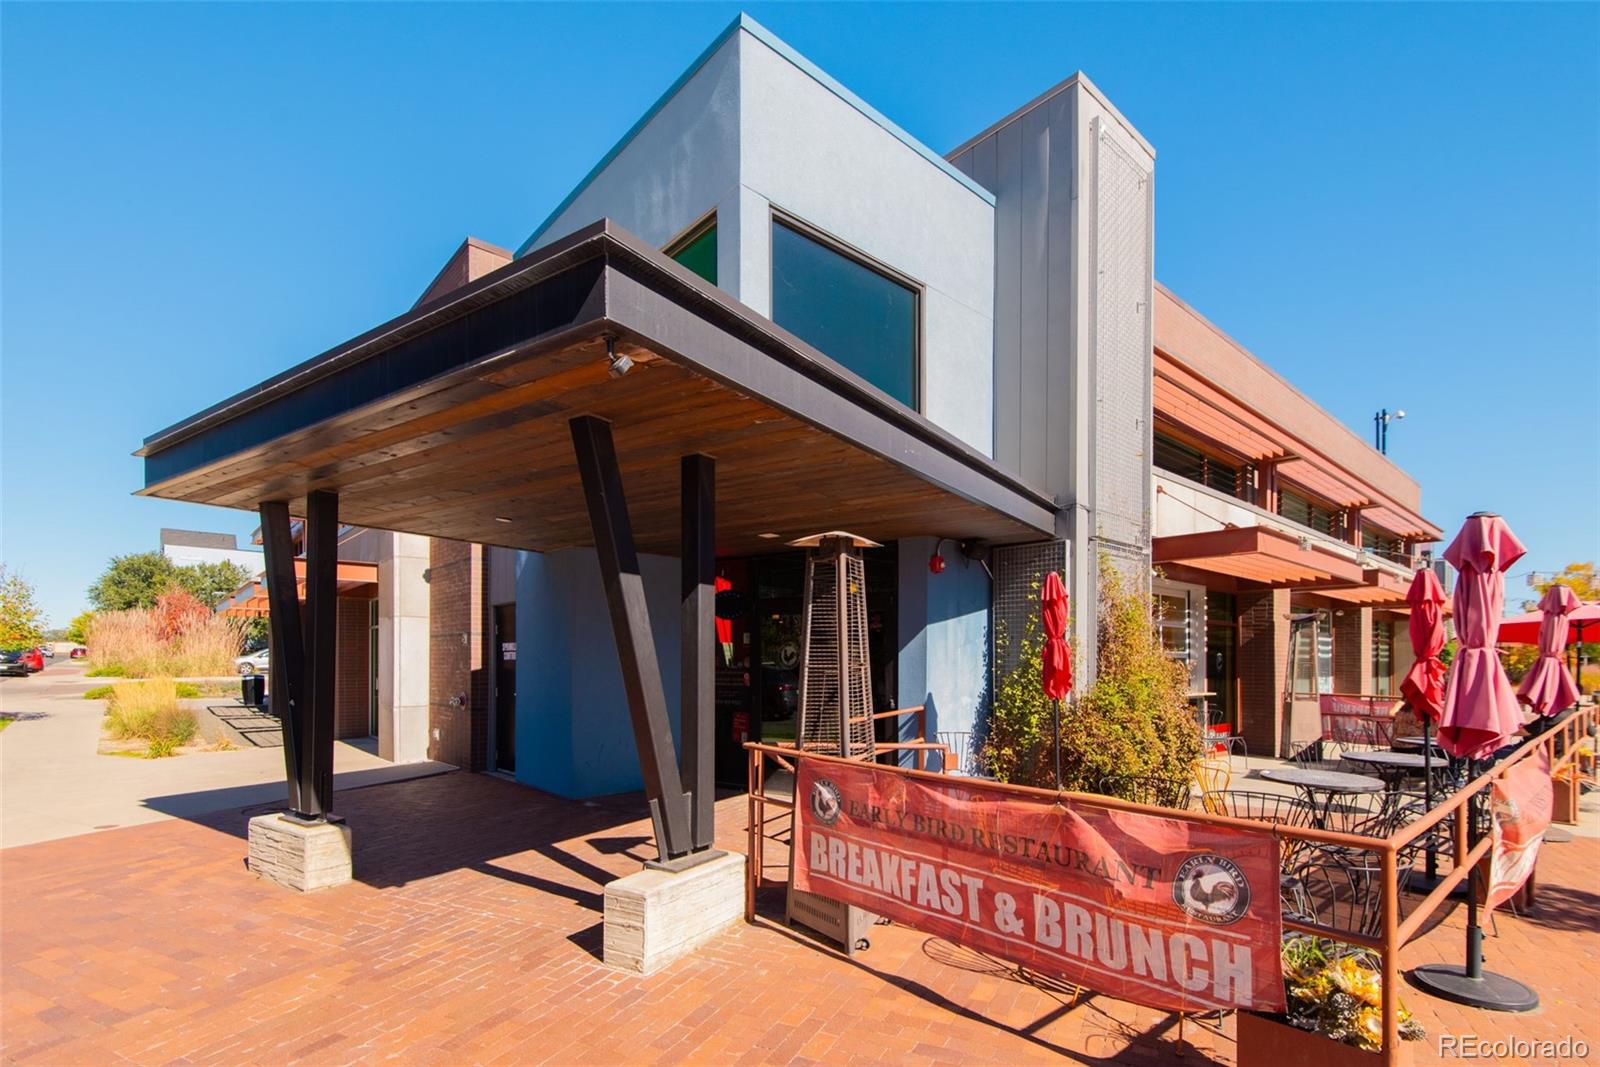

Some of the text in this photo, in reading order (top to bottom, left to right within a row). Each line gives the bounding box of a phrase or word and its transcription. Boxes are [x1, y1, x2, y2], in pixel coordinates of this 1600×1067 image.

[849, 800, 907, 828] EARLY
[913, 813, 965, 841] BIRD
[972, 827, 1161, 889] RESTAURANT
[1179, 856, 1244, 887] EARLY BIRD
[811, 831, 1252, 1006] BREAKFAST & BRUNCH
